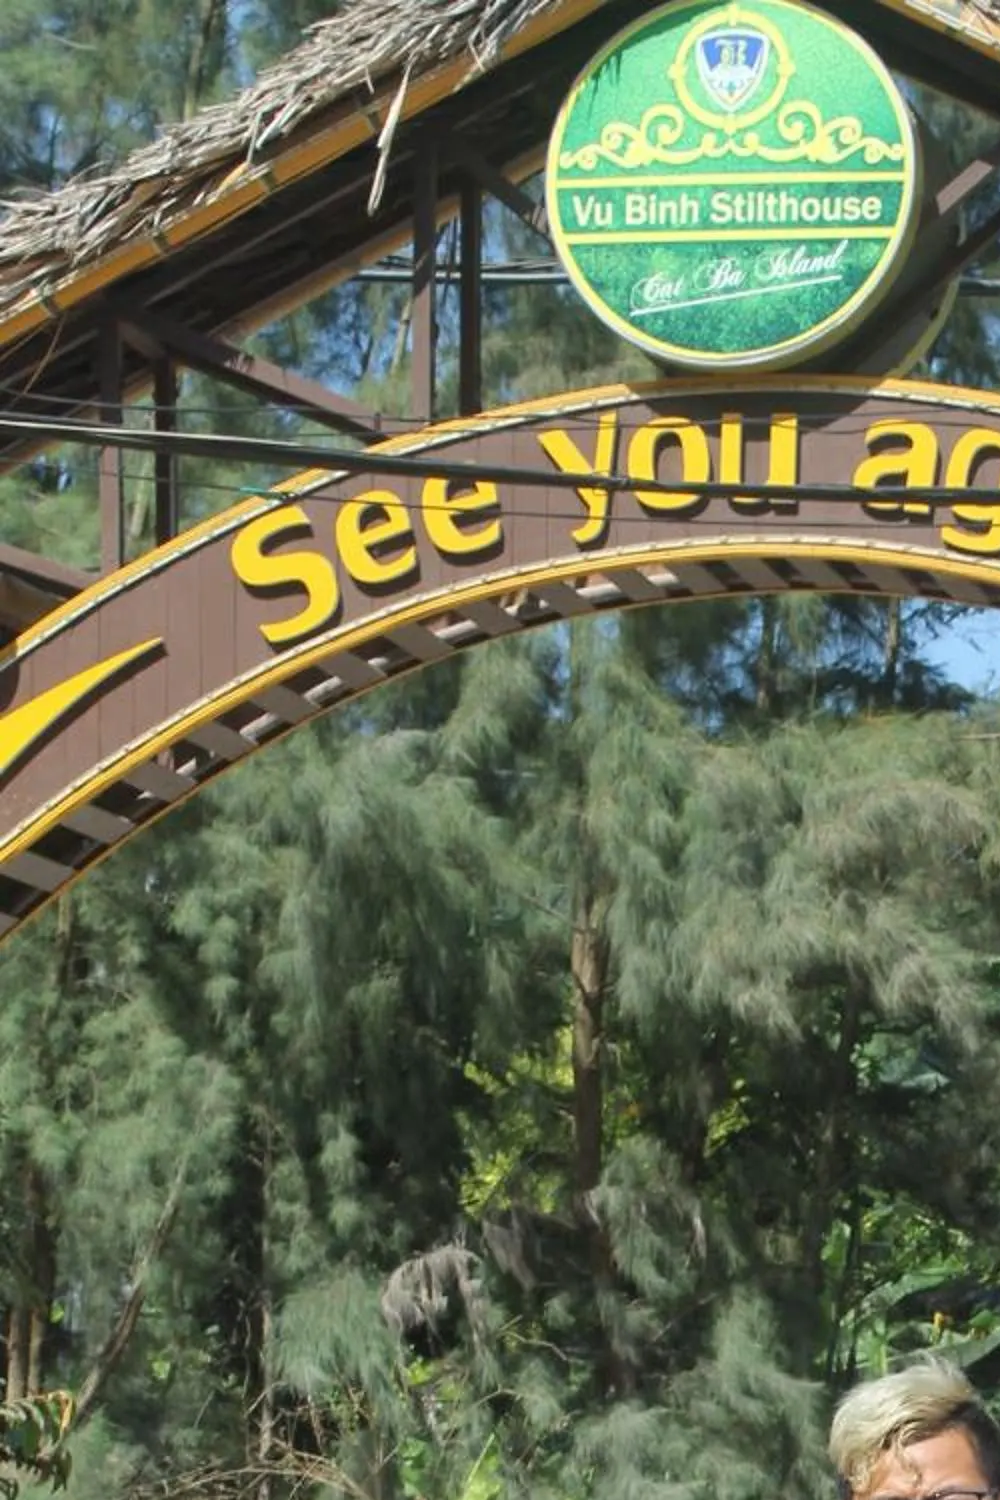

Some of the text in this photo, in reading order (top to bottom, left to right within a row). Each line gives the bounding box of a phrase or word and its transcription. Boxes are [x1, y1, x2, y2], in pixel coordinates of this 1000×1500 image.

[573, 191, 882, 227] Vu Binh Stilthouse
[692, 256, 746, 291] Ba
[753, 239, 849, 281] Island
[231, 476, 500, 643] See
[537, 411, 798, 543] you
